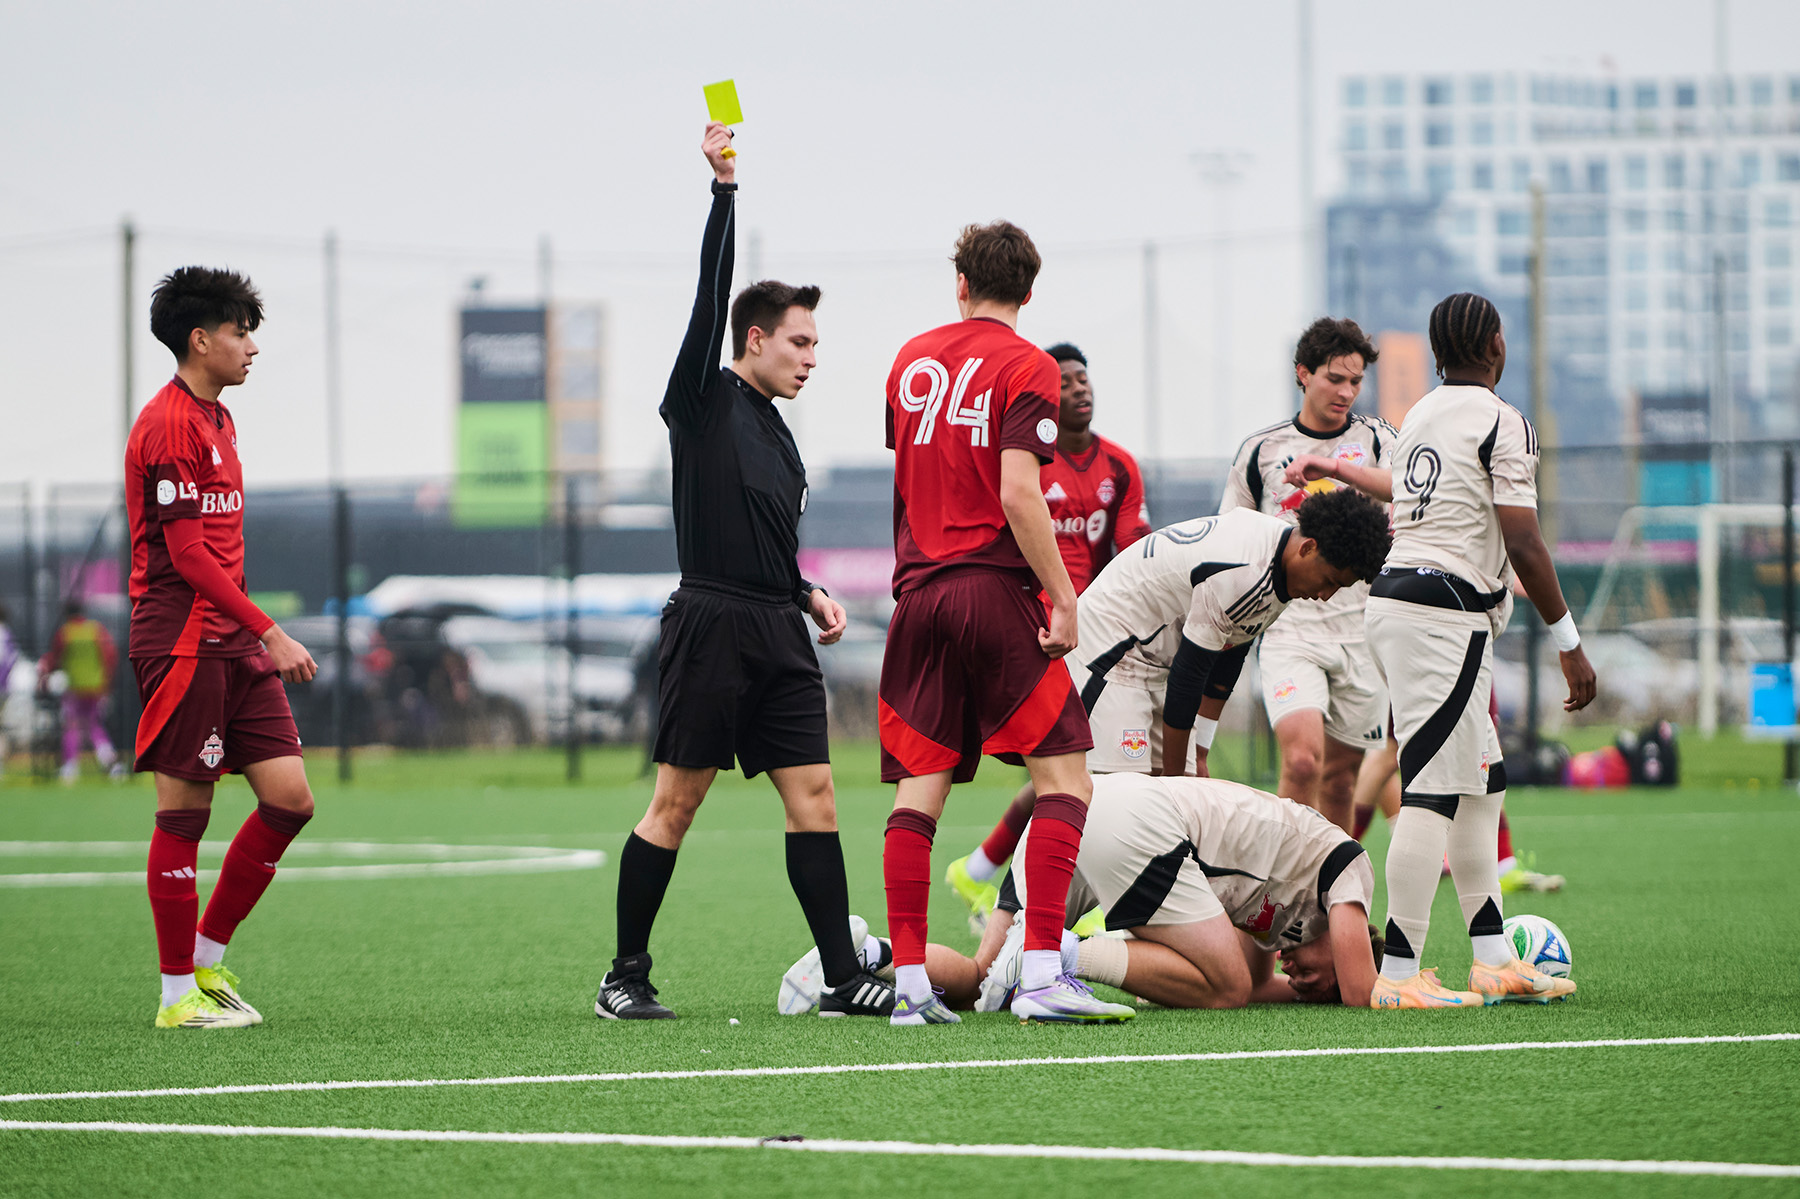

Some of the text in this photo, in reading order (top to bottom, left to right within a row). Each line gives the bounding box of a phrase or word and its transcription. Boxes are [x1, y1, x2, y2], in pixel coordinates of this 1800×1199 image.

[898, 356, 992, 447] 94
[179, 481, 198, 500] LG
[201, 489, 242, 513] BMO
[1403, 442, 1442, 522] 9
